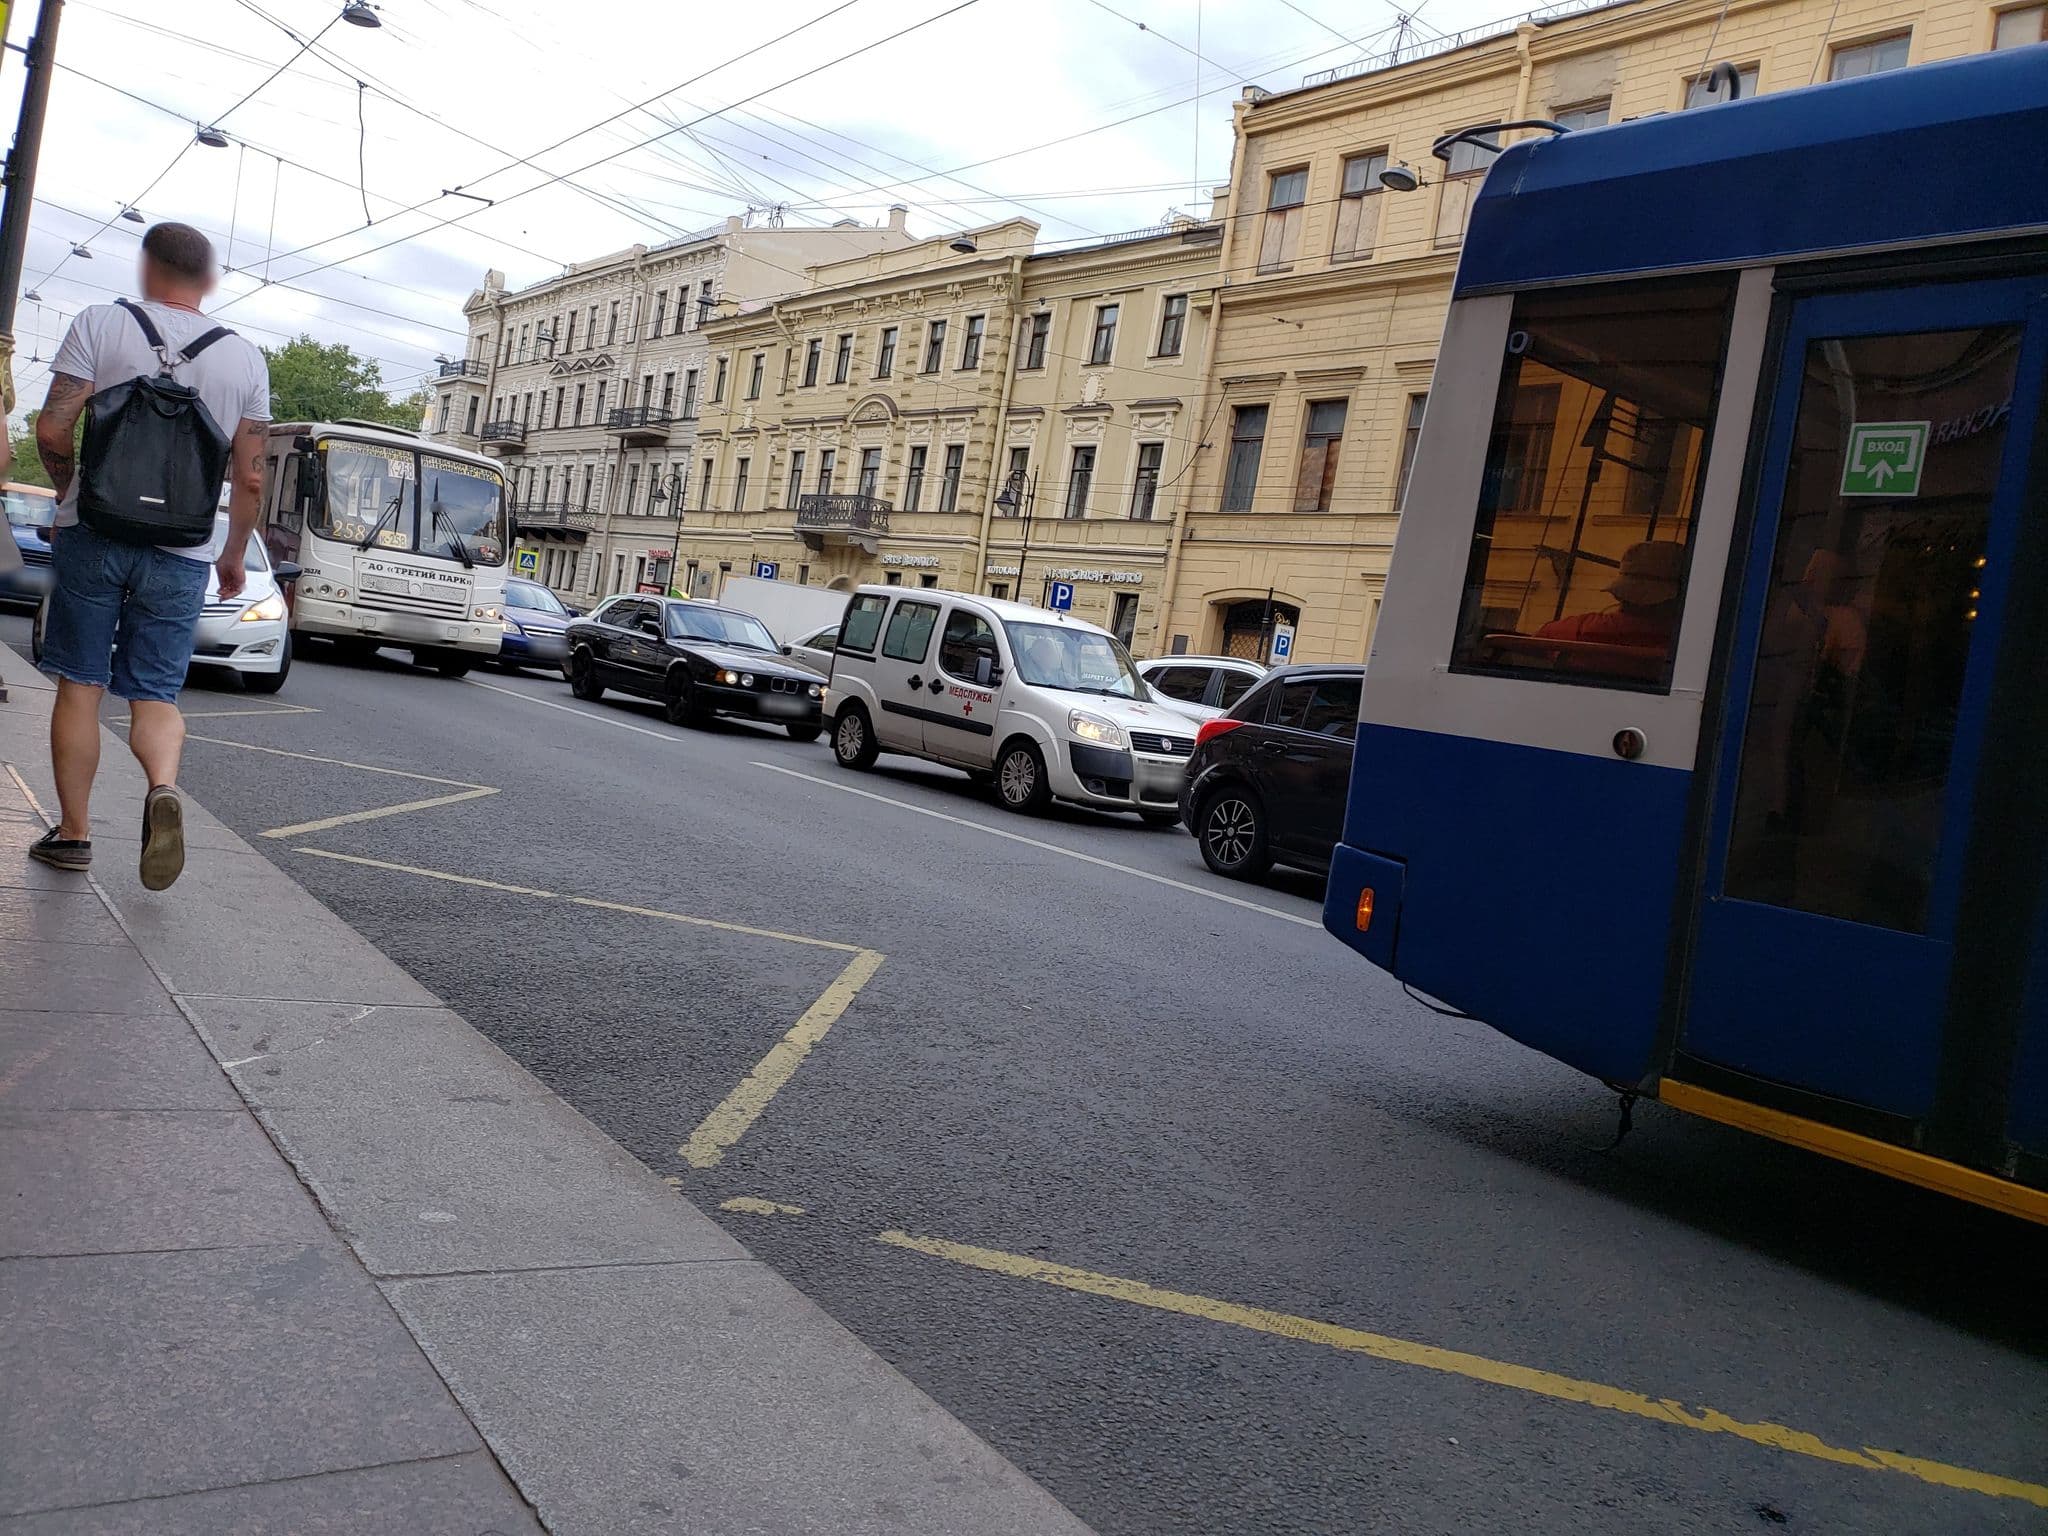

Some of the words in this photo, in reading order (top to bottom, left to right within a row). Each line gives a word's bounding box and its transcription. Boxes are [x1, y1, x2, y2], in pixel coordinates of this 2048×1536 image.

[1867, 441, 1906, 454] ВХОД
[333, 520, 366, 542] 258
[368, 563, 384, 572] АО
[387, 567, 436, 580] «ТРЕТИЙ
[439, 574, 473, 586] ПАРК»
[949, 685, 992, 703] МЕДСЛУЖБА
